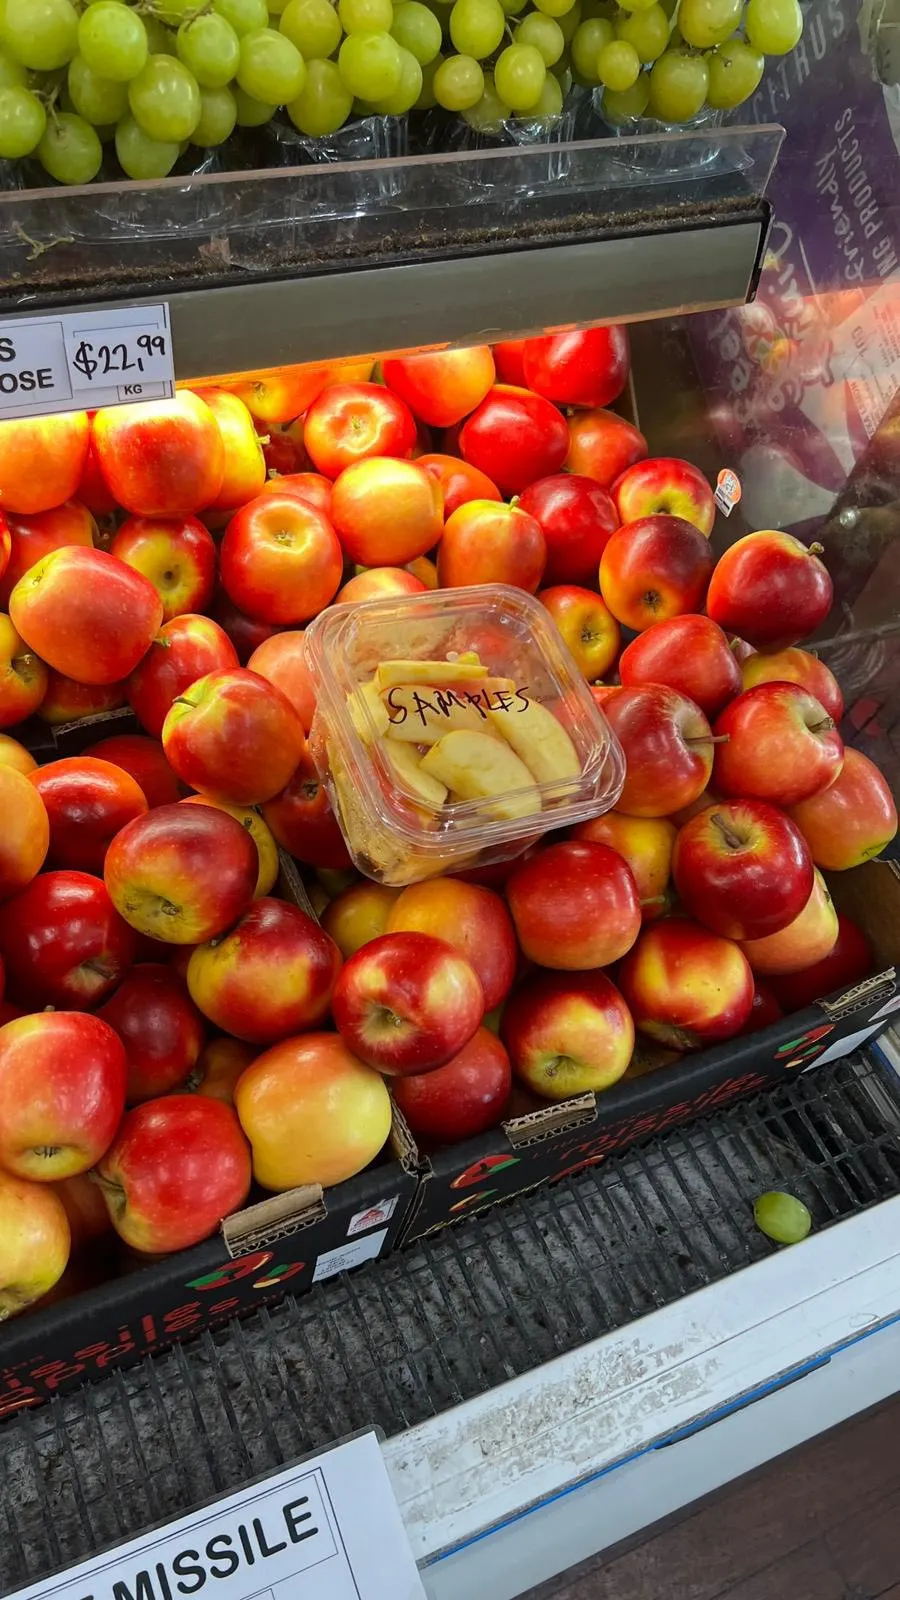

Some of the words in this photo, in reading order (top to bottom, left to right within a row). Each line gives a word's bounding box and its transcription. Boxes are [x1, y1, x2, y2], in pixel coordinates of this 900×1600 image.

[834, 107, 883, 240] PRODUCTS
[124, 384, 143, 396] KG
[388, 687, 529, 726] SAMPLES
